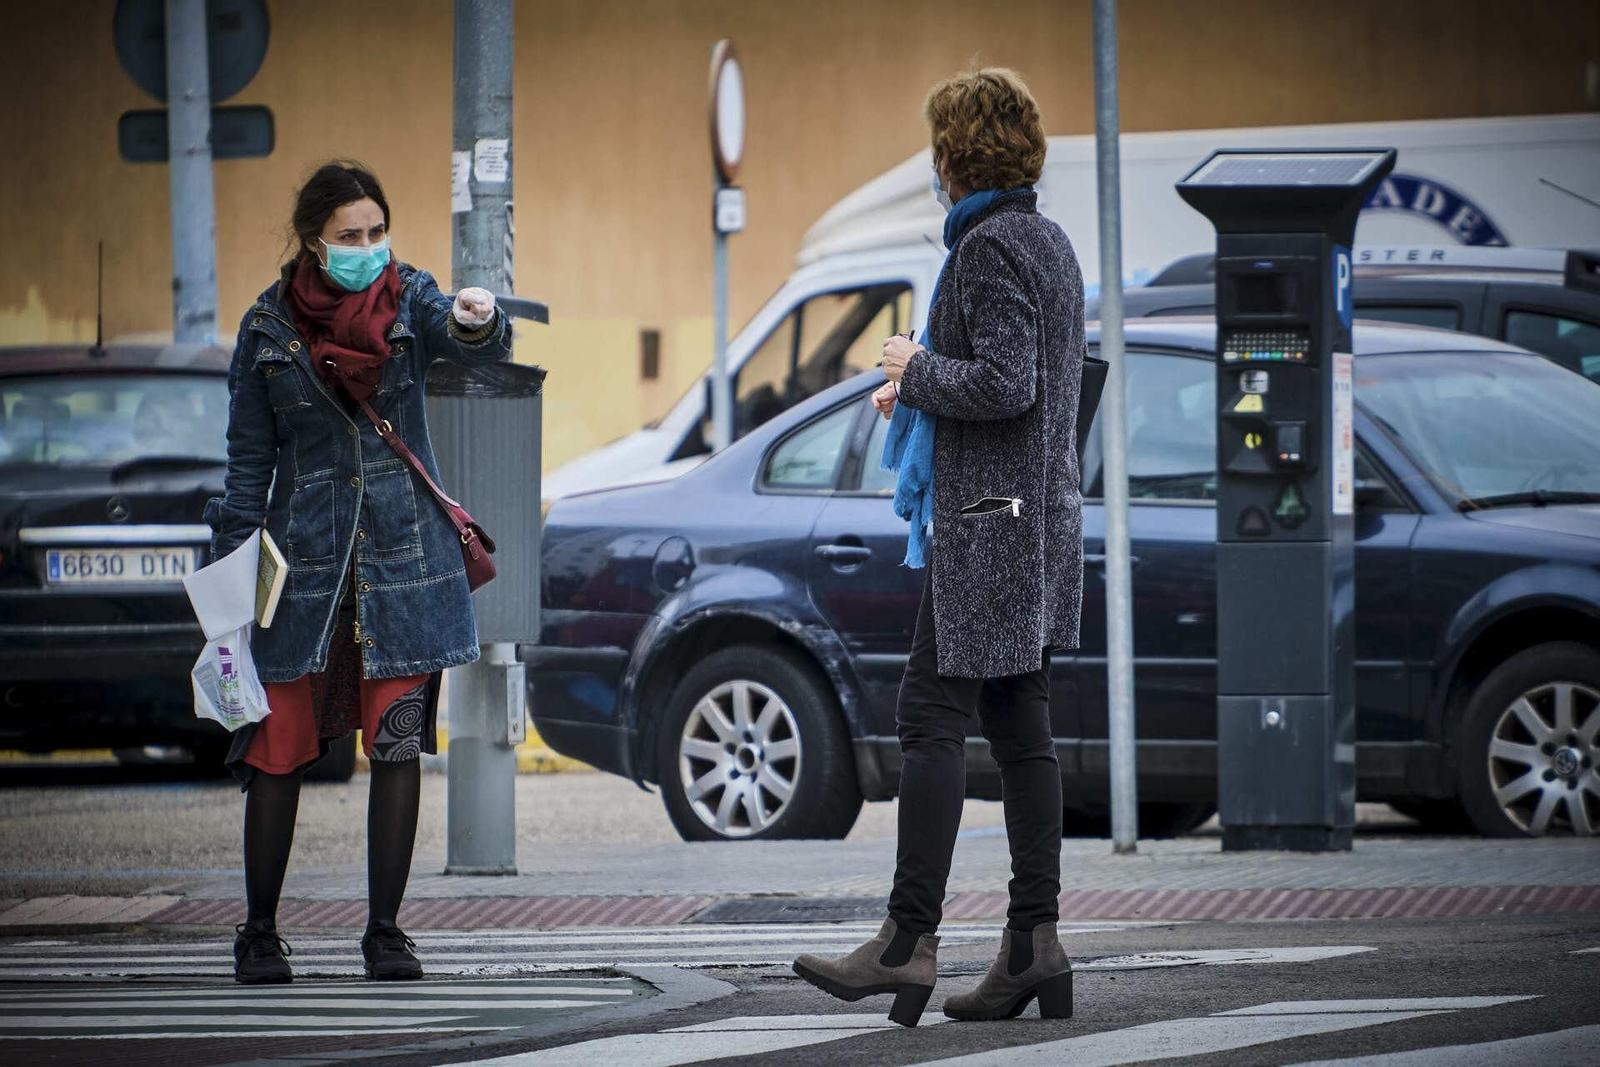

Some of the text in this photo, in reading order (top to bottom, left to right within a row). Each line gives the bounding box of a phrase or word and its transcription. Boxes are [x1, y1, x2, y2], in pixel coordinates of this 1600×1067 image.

[1371, 177, 1503, 245] ADE
[1337, 253, 1350, 311] P
[63, 554, 187, 577] 6630 DTN
